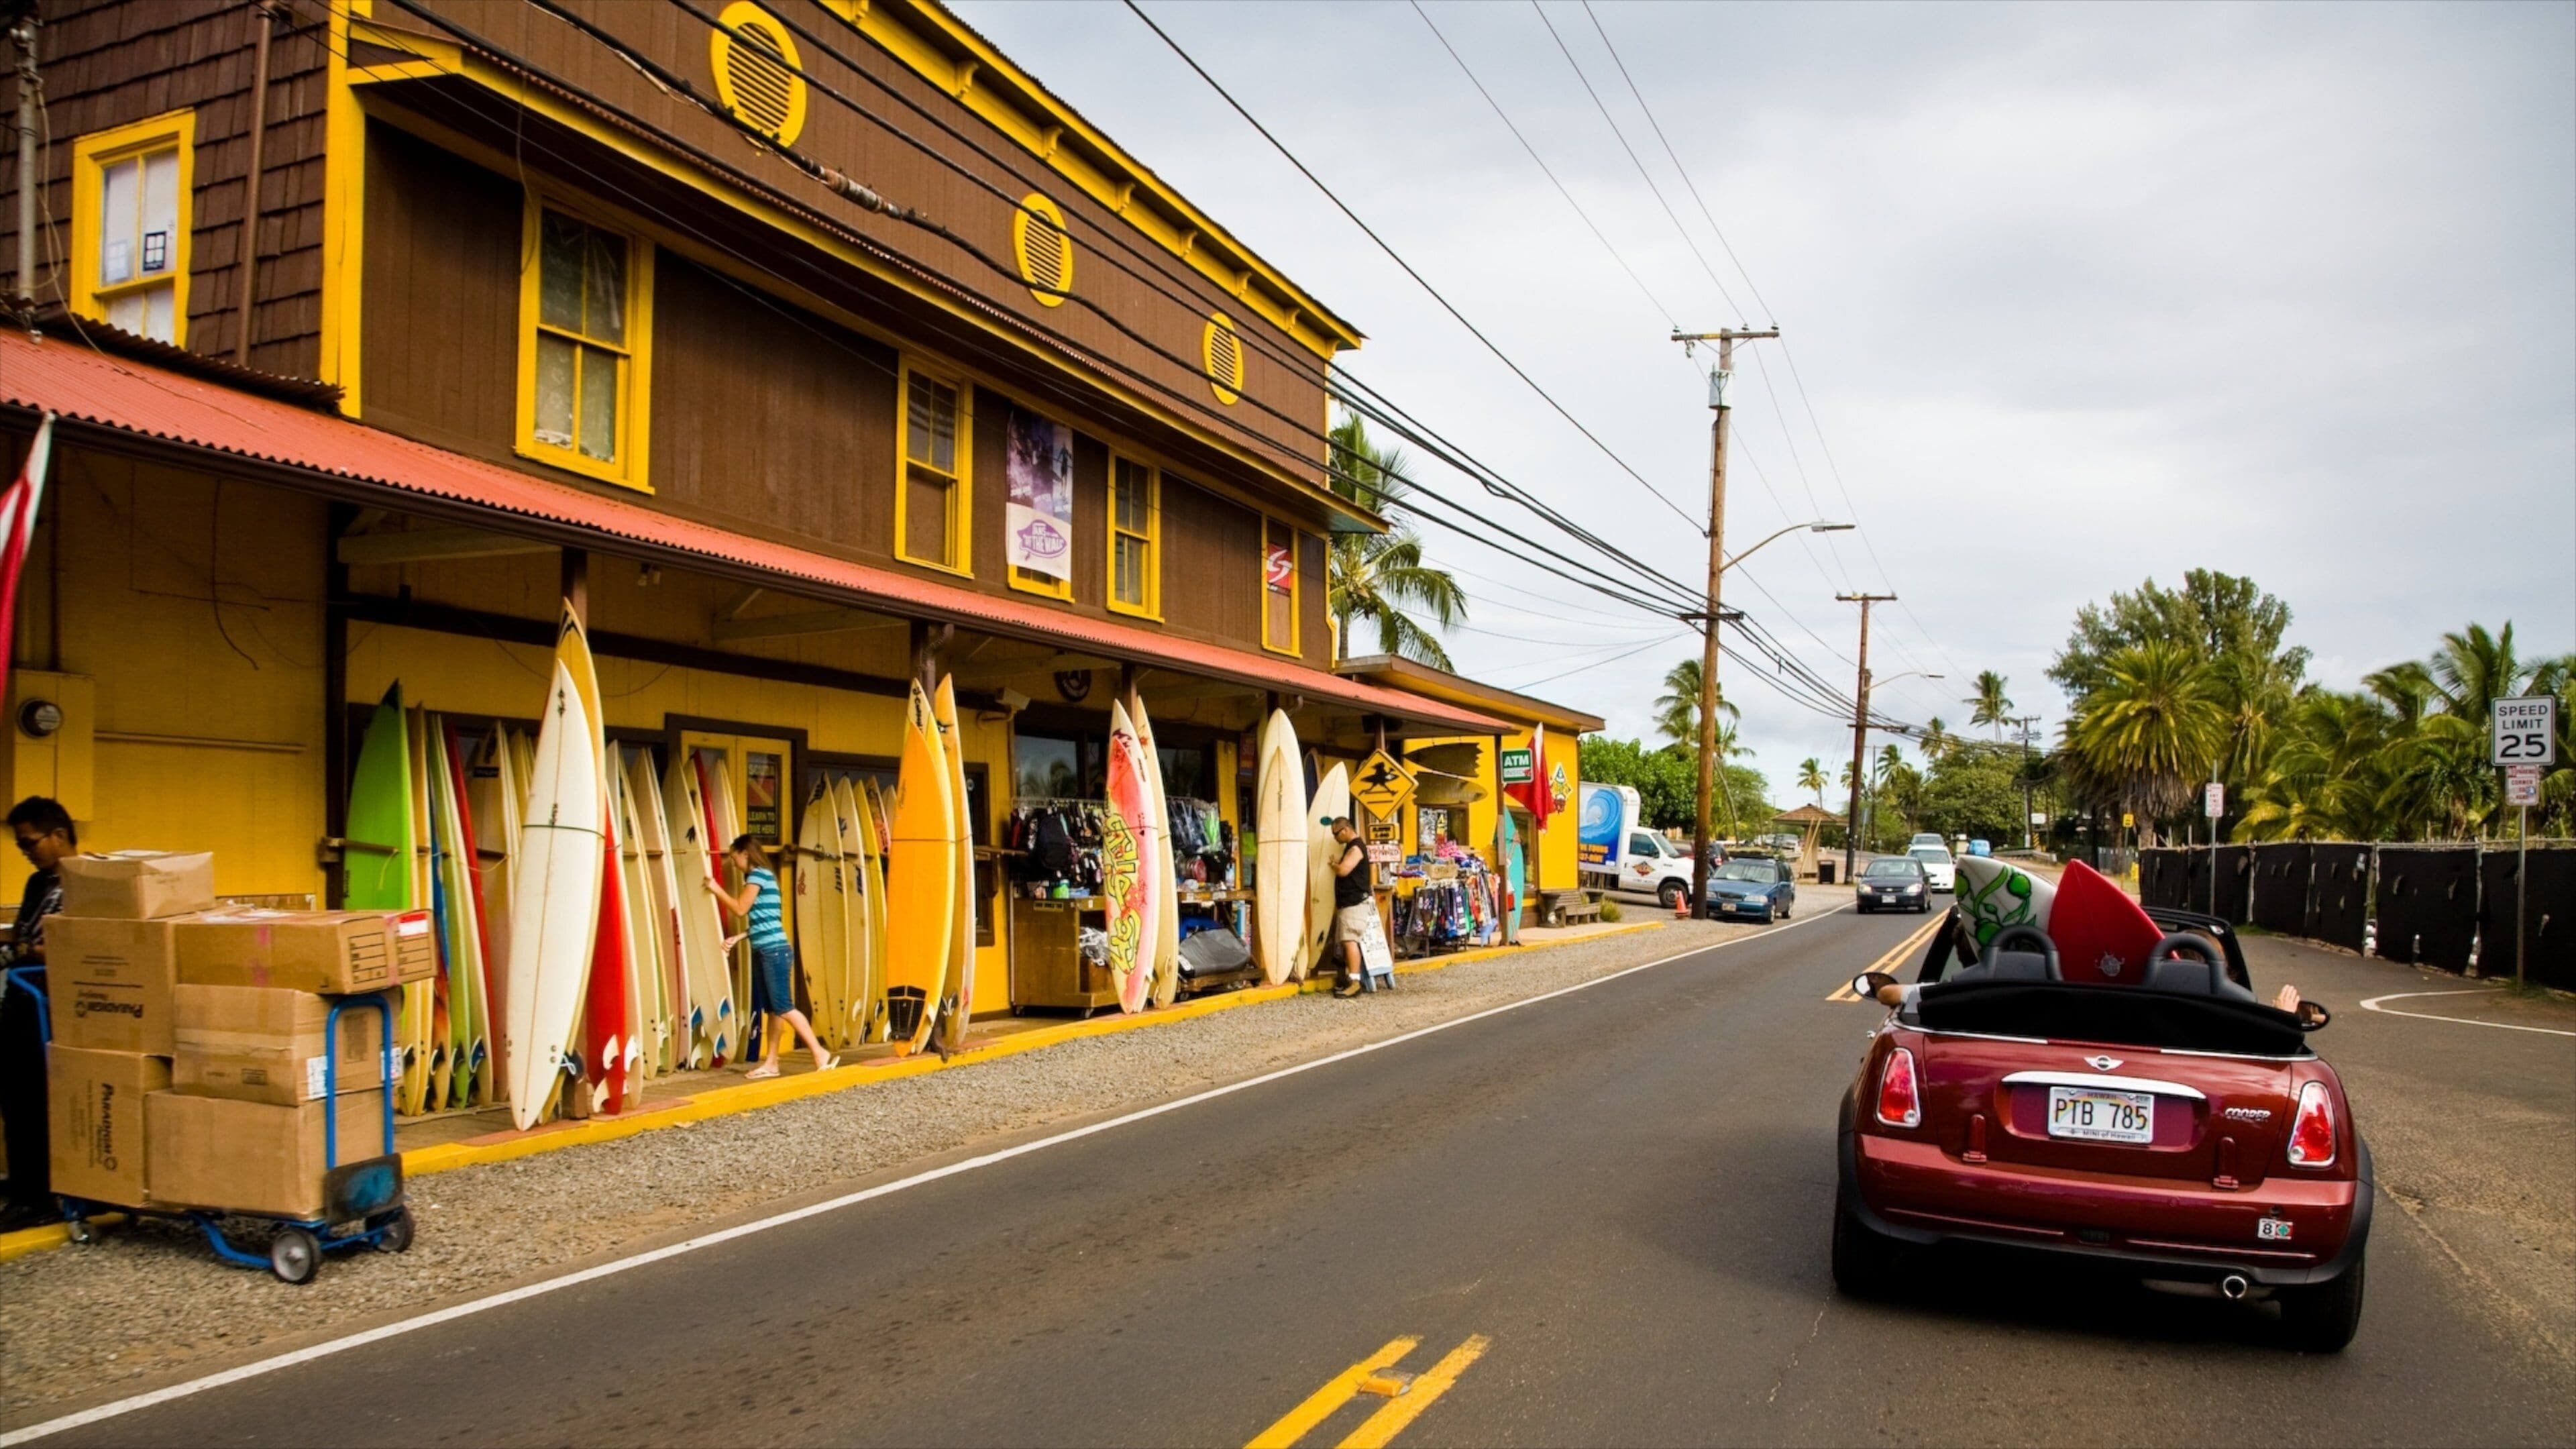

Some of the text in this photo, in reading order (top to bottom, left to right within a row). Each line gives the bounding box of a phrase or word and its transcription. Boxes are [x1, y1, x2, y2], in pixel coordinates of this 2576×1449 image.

[2498, 705, 2548, 716] SPEED
[2502, 719, 2542, 730] LIMIT
[2500, 733, 2546, 757] 25
[1504, 755, 1529, 766] ATM
[749, 811, 775, 821] LEARN TO
[2087, 1092, 2118, 1101] HAWAII
[2055, 1098, 2148, 1130] PTB 785
[2224, 1107, 2271, 1119] COOPER
[2263, 1223, 2273, 1235] 8
